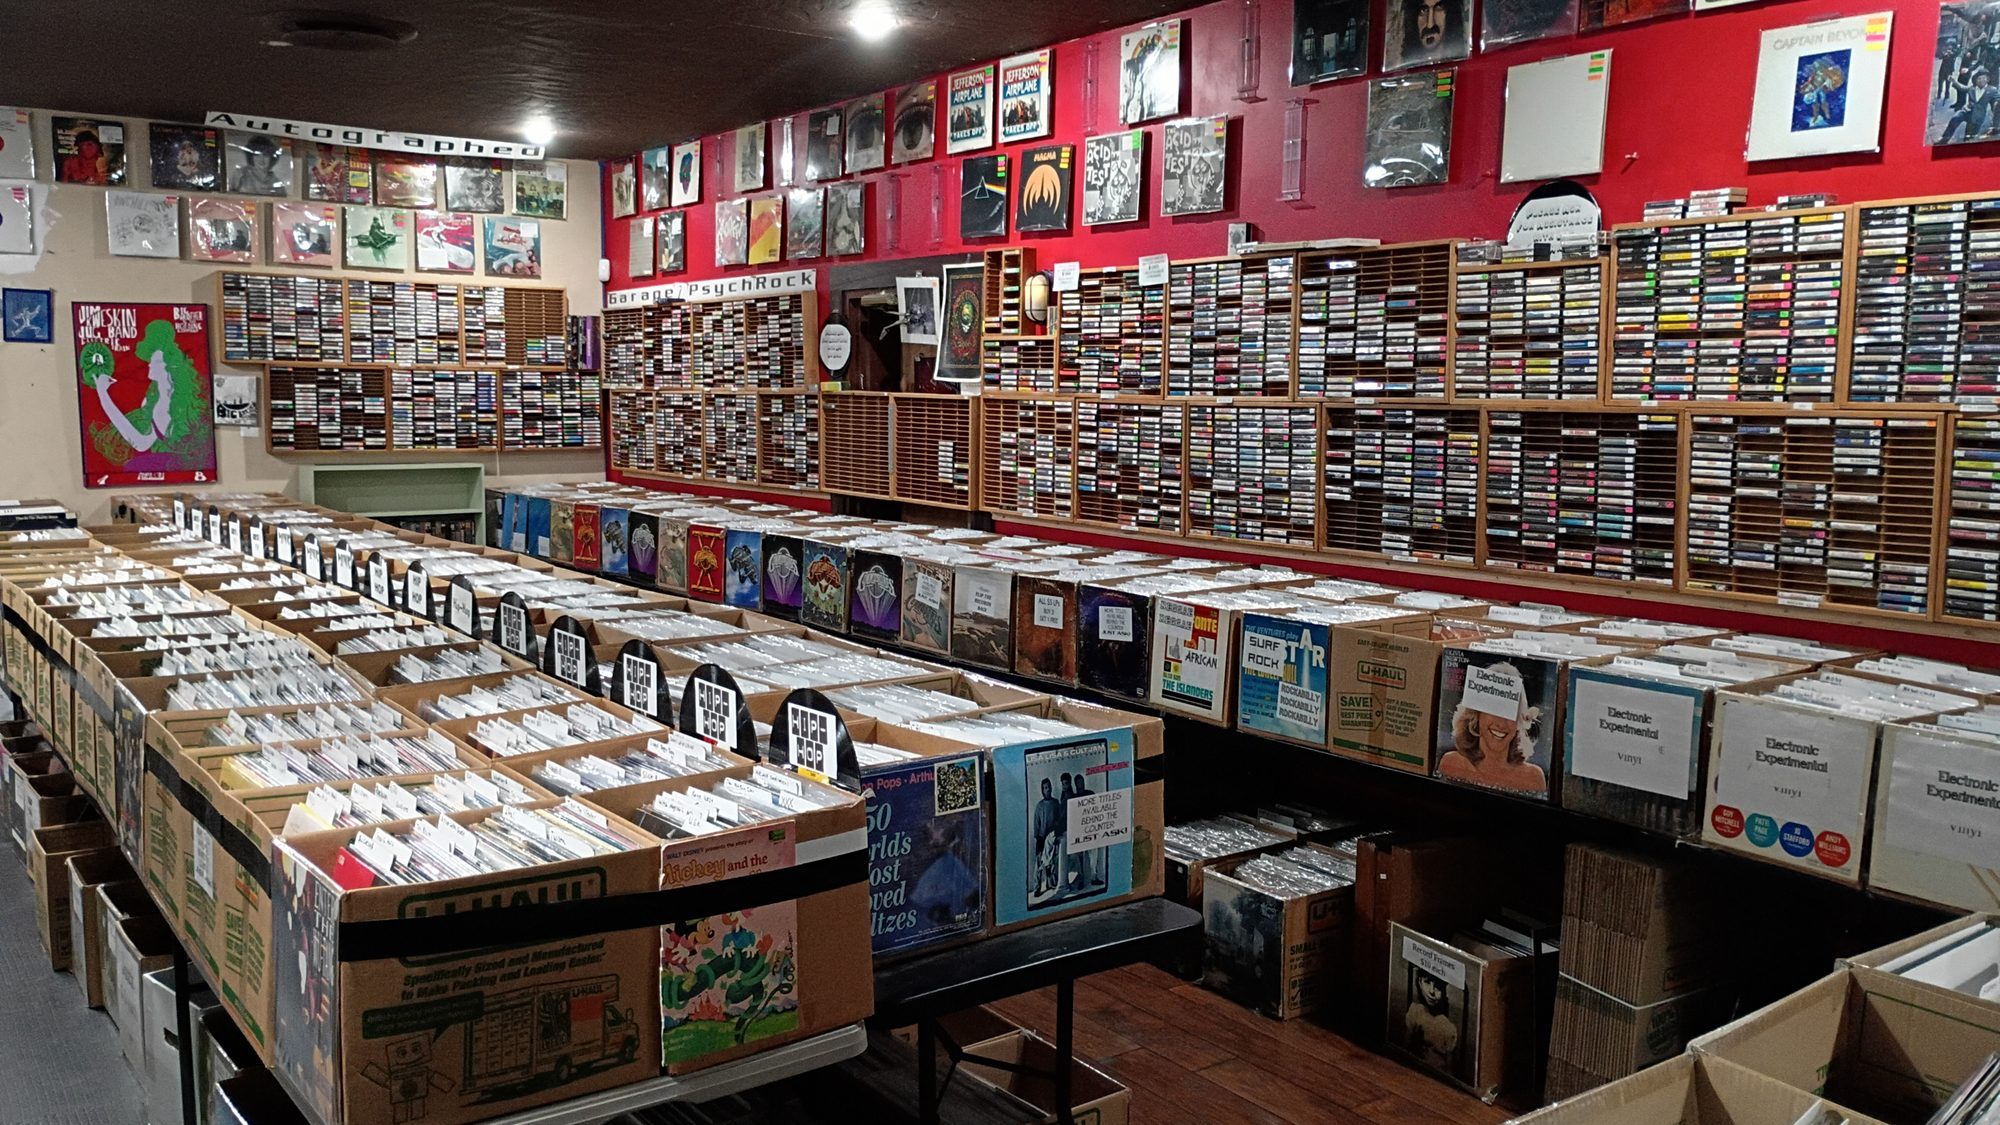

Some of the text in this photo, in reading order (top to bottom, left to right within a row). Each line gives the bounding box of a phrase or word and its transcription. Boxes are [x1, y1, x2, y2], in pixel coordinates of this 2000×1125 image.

[1773, 34, 1824, 51] CAPTAIN
[953, 72, 984, 91] JEFFERSON
[1005, 65, 1040, 84] JEFFERSON
[954, 86, 983, 104] AIRPLANE
[1006, 79, 1038, 97] AIRPLANE
[1166, 132, 1192, 150] ACID
[1087, 144, 1111, 164] ACID
[1166, 150, 1191, 174] TEST
[1087, 162, 1111, 186] TEST
[107, 325, 137, 339] BAND
[1249, 636, 1280, 652] SURF
[1185, 651, 1218, 669] AFRICAN
[1247, 652, 1279, 670] ROCK
[1361, 665, 1403, 681] U-HAUL
[1477, 669, 1514, 687] Electronic
[1163, 679, 1214, 700] THE ISLANDERS
[1281, 684, 1320, 702] ROCKABILLY
[1468, 680, 1519, 702] Experimental
[1280, 696, 1320, 715] ROCKABILLY
[1340, 696, 1373, 708] SAVE!
[1279, 708, 1319, 727] ROCKABILLY
[1607, 706, 1652, 725] Electronic
[1599, 718, 1659, 740] Experimental
[1070, 746, 1088, 757] CULT
[1088, 743, 1105, 754] JAM
[1765, 737, 1820, 757] Electronic
[1755, 751, 1828, 773] Experimental
[877, 777, 902, 791] Pops
[1938, 770, 1999, 793] Electronic
[1078, 792, 1122, 808] MORE TITLES
[1082, 802, 1117, 816] AVAILABLE
[1081, 811, 1119, 826] BEHIND THE
[1084, 821, 1115, 834] COUNTER
[1071, 828, 1128, 846] JUST ASK!
[1754, 826, 1768, 836] PAGE
[1783, 833, 1810, 847] STAFFORD
[1825, 834, 1842, 844] ANDY
[727, 856, 749, 872] and
[751, 853, 768, 867] the
[1412, 943, 1433, 959] Record
[403, 938, 606, 987] Specifically Sized and Manufactured
[401, 989, 414, 1000] to
[417, 983, 449, 997] Make
[452, 974, 498, 992] Packing
[499, 968, 521, 982] and
[522, 959, 567, 977] Loading
